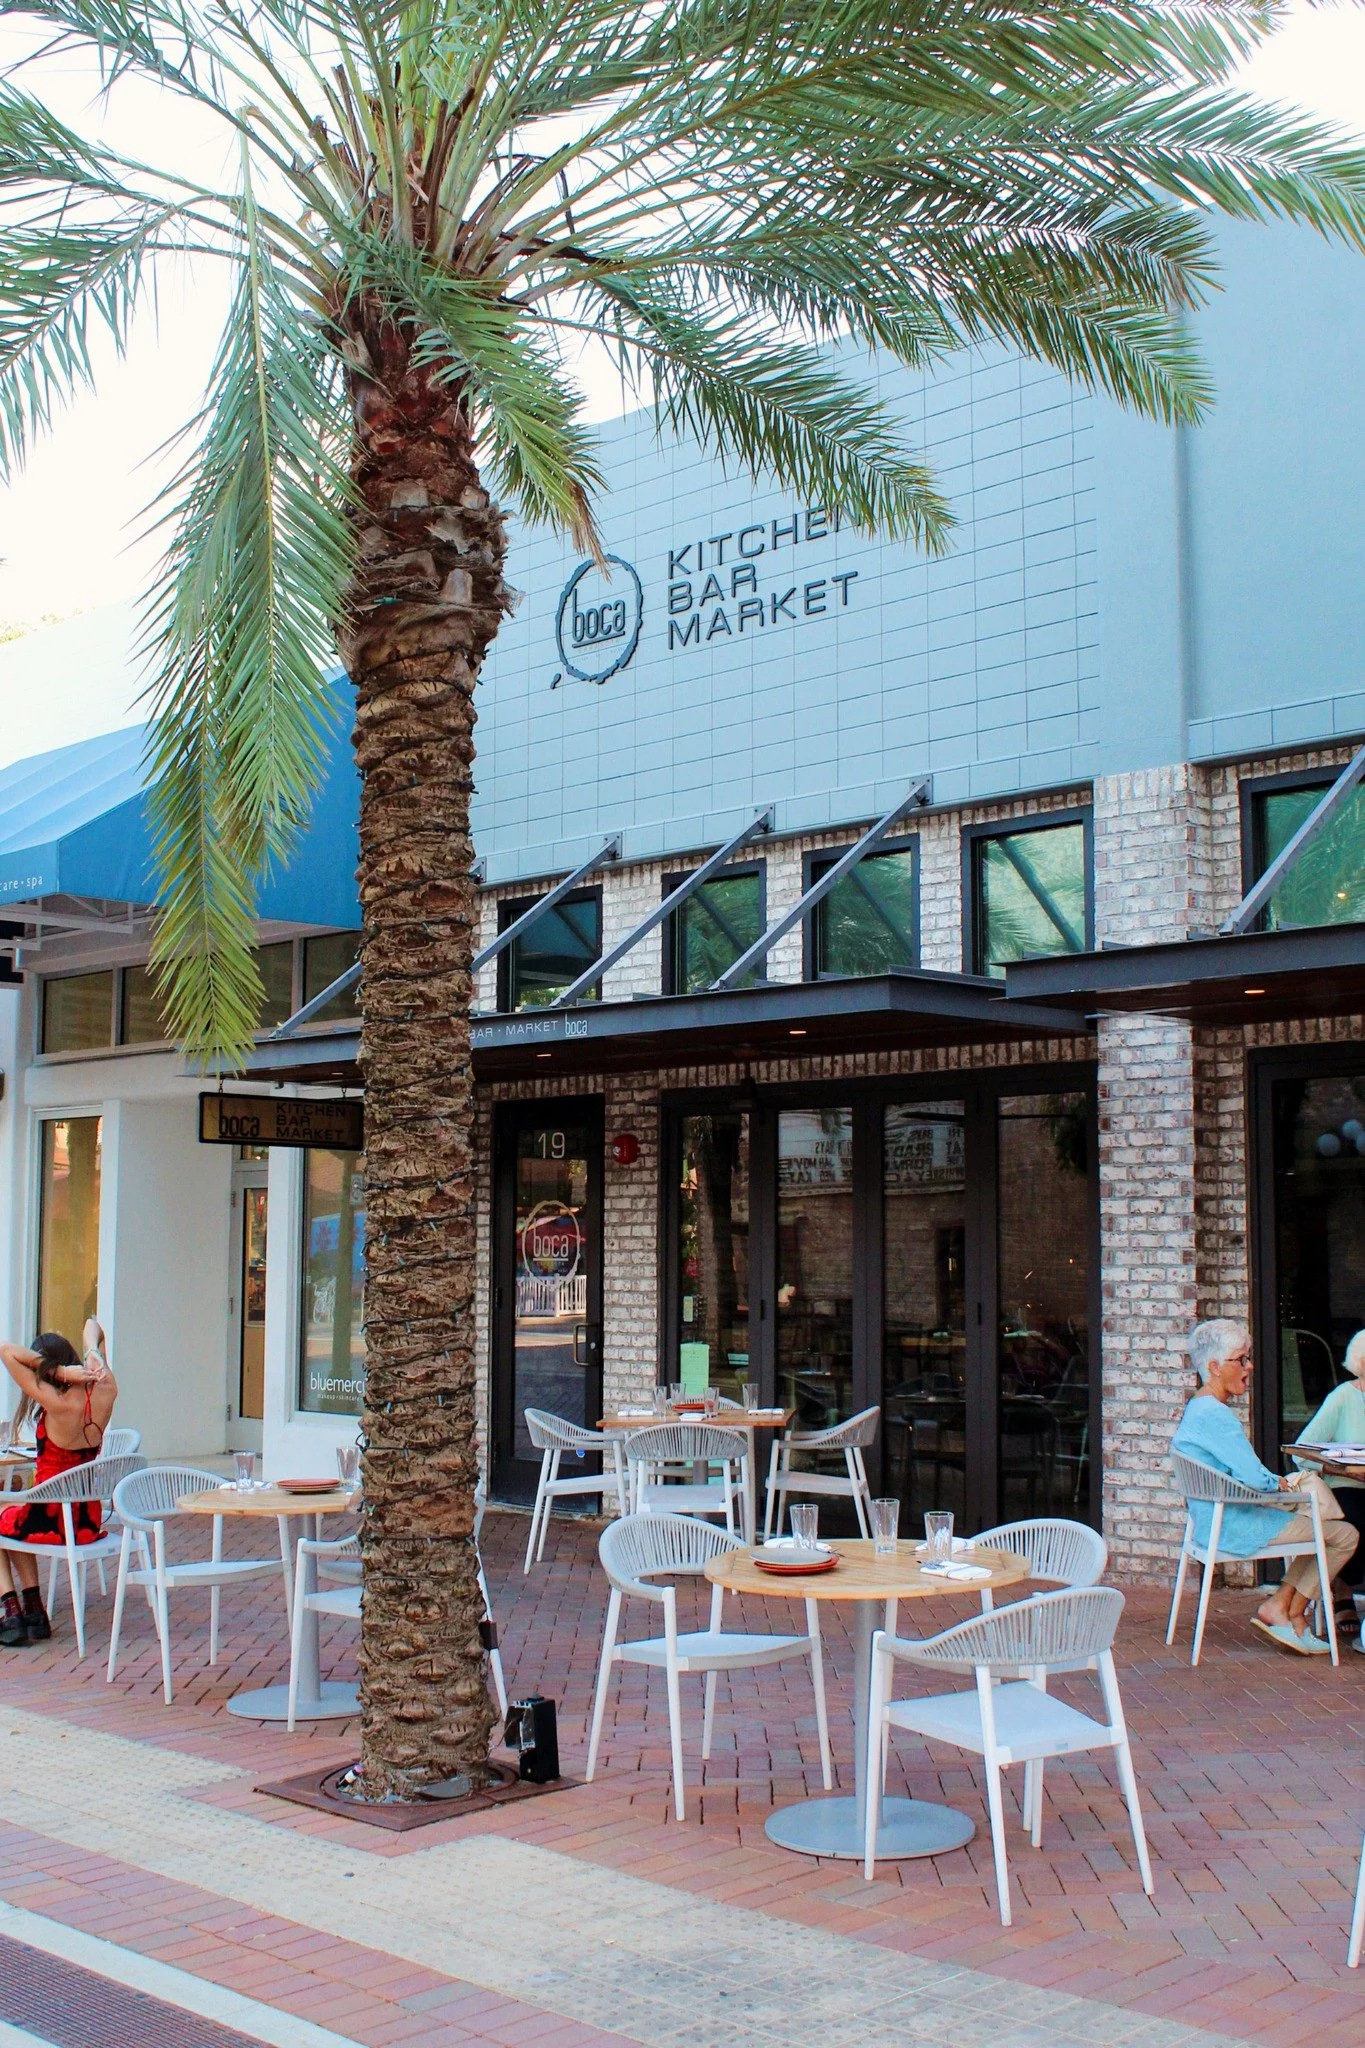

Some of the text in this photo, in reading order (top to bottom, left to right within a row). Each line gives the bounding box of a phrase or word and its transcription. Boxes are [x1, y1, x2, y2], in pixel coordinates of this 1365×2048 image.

[668, 563, 757, 615] BAR
[573, 588, 625, 642] boca
[668, 571, 859, 650] MARKET
[26, 876, 42, 889] spa
[505, 1020, 558, 1036] MARKET
[565, 1013, 588, 1035] boca
[219, 1099, 260, 1137] boca
[276, 1102, 346, 1118] KITCHEN
[276, 1114, 310, 1128] BAR
[276, 1126, 343, 1140] MARKET
[538, 1131, 566, 1160] 19
[533, 1217, 569, 1258] boca
